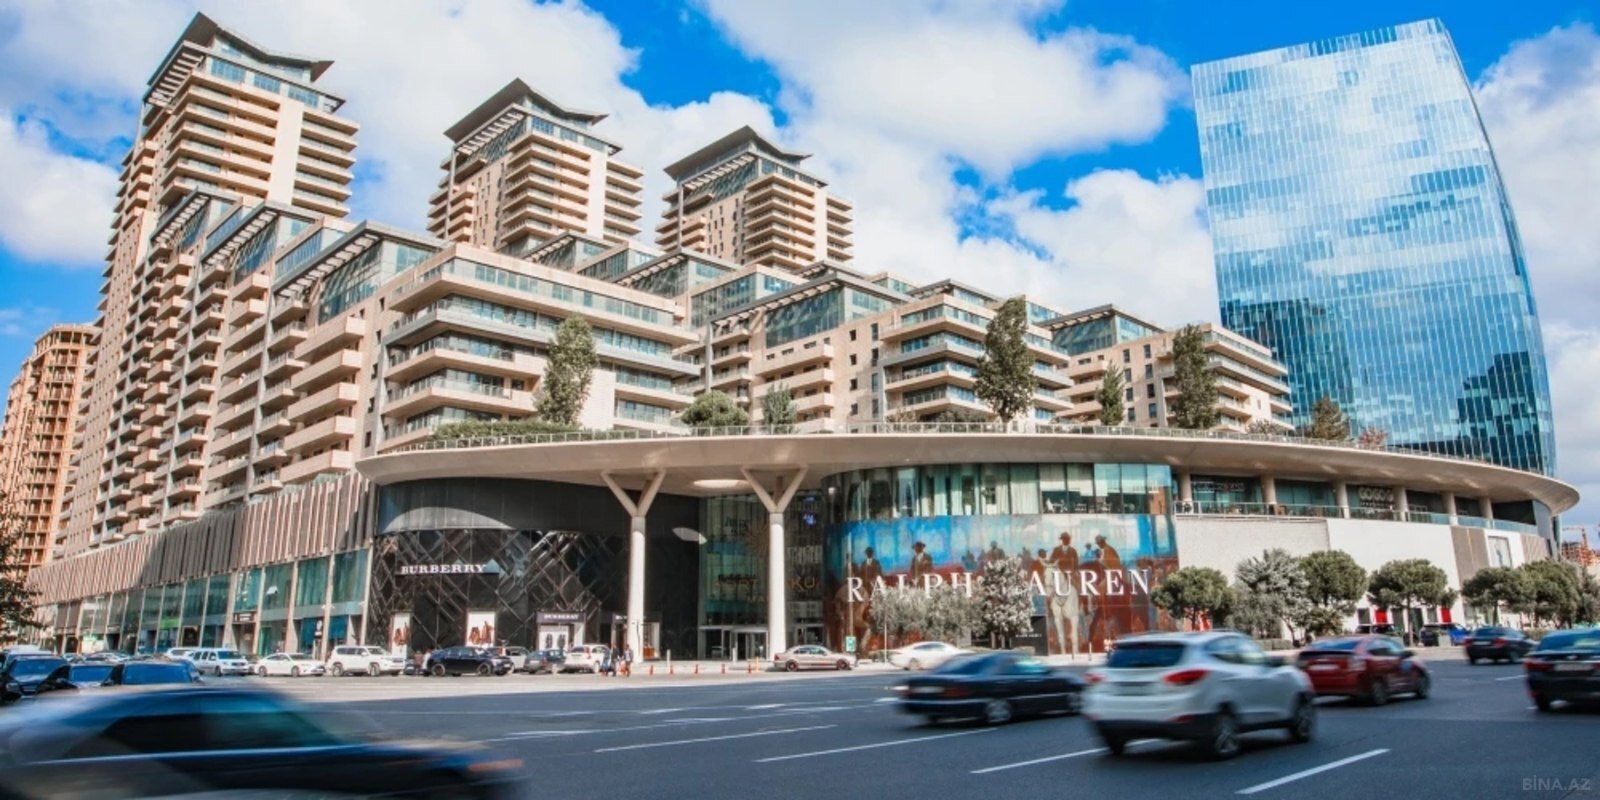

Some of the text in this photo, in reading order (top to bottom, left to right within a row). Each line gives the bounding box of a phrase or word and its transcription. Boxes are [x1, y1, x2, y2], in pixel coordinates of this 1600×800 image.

[401, 564, 486, 575] BURBERRY
[846, 569, 1149, 603] RALPH AUREN
